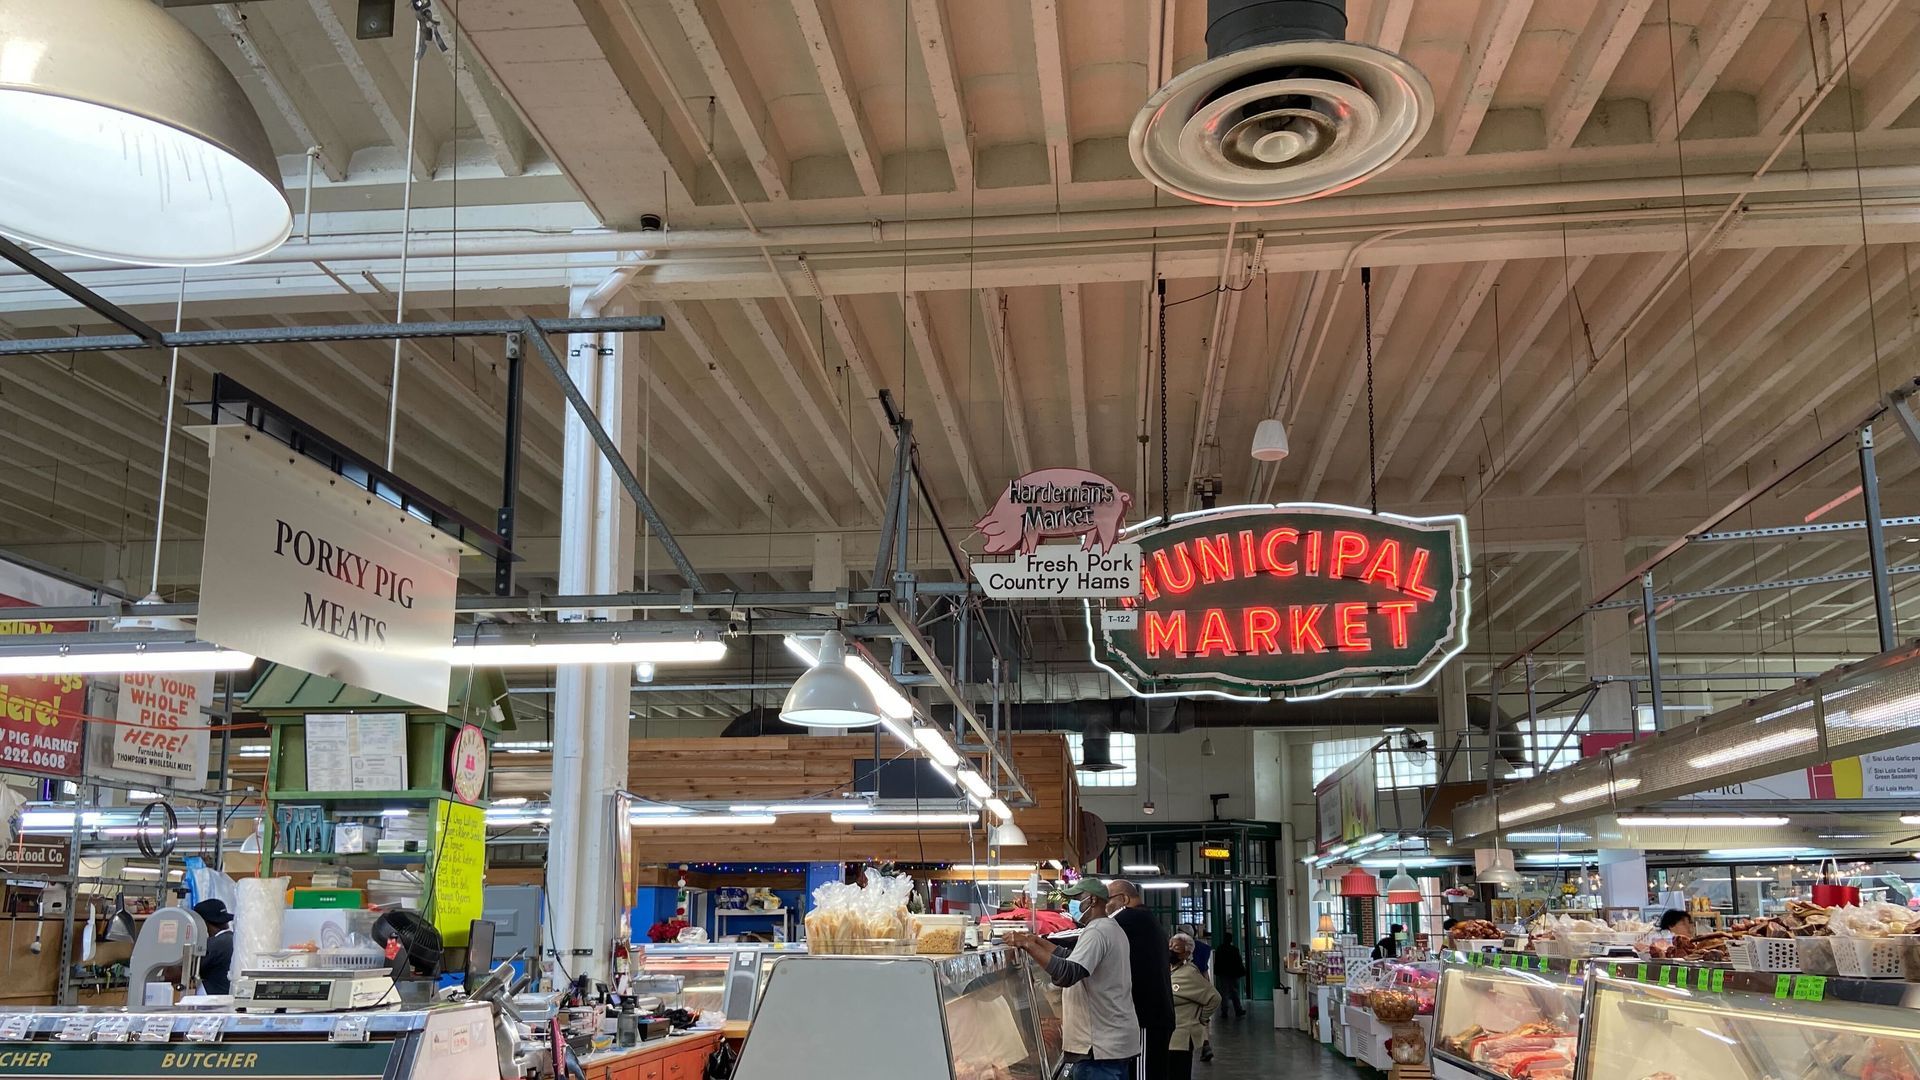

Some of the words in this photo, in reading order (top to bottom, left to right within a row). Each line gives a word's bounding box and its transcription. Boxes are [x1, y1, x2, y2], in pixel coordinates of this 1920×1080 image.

[1024, 506, 1095, 532] Market
[274, 519, 371, 590] PORKY
[374, 564, 414, 609] PIG
[1027, 554, 1078, 572] Fresh
[1088, 553, 1133, 572] Pork
[989, 573, 1069, 594] Country
[1077, 573, 1130, 589] Hams
[301, 592, 387, 650] MEATS
[1108, 615, 1130, 623] T-122
[1146, 601, 1418, 660] MARKET
[124, 672, 155, 689] BUY
[161, 678, 197, 700] YOUR
[131, 688, 189, 715] WHOLE
[140, 709, 179, 729] PIGS
[8, 729, 30, 746] PIG
[33, 734, 79, 754] MARKET
[123, 728, 189, 753] HERE!
[48, 848, 65, 863] Co.
[161, 1053, 258, 1068] BUTCHER
